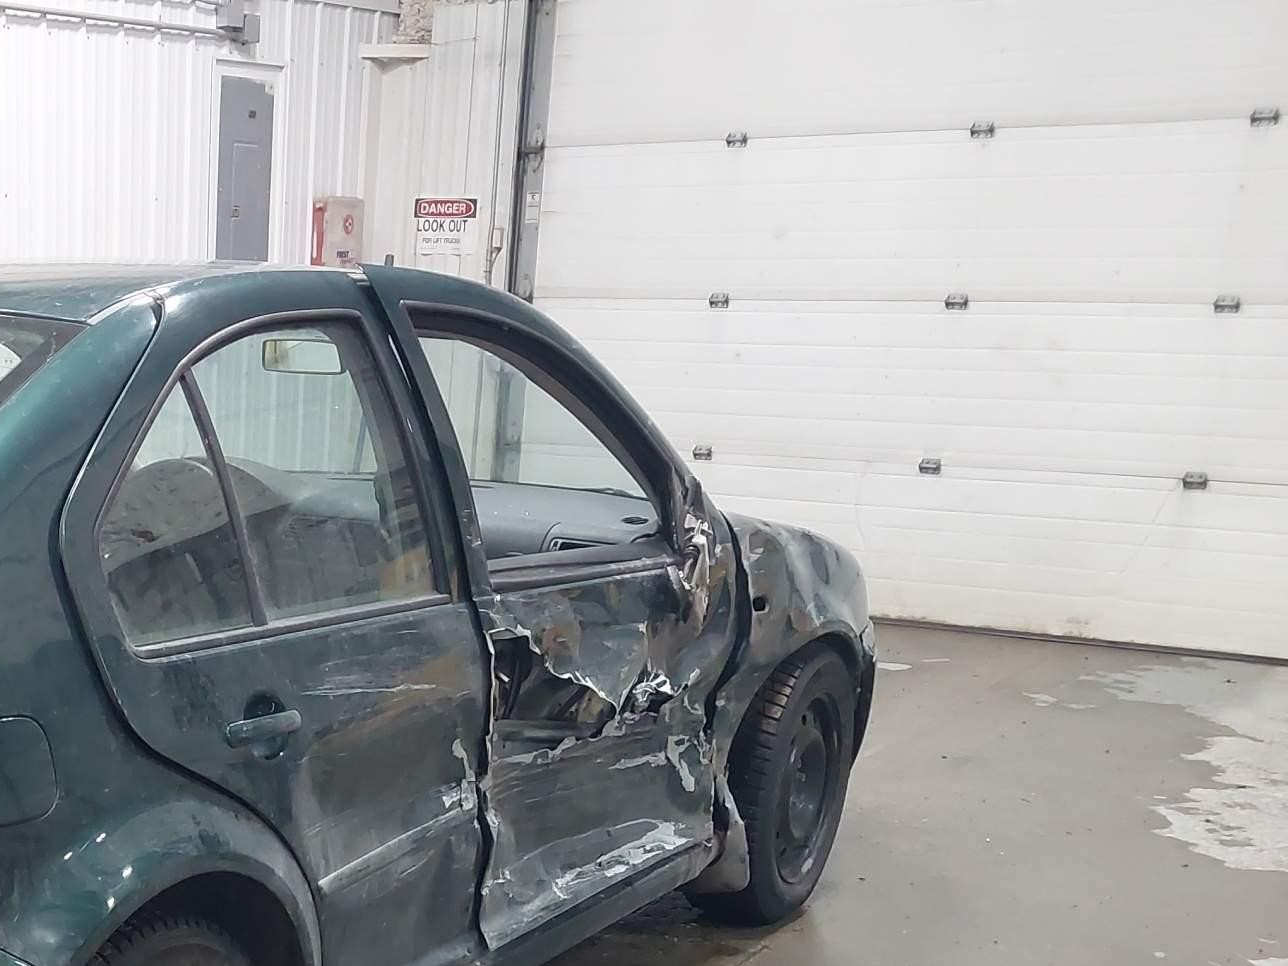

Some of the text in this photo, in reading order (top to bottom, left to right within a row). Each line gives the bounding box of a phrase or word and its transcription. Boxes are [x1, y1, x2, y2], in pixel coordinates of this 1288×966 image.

[420, 202, 467, 214] DANGER
[416, 219, 468, 232] LOOK OUT
